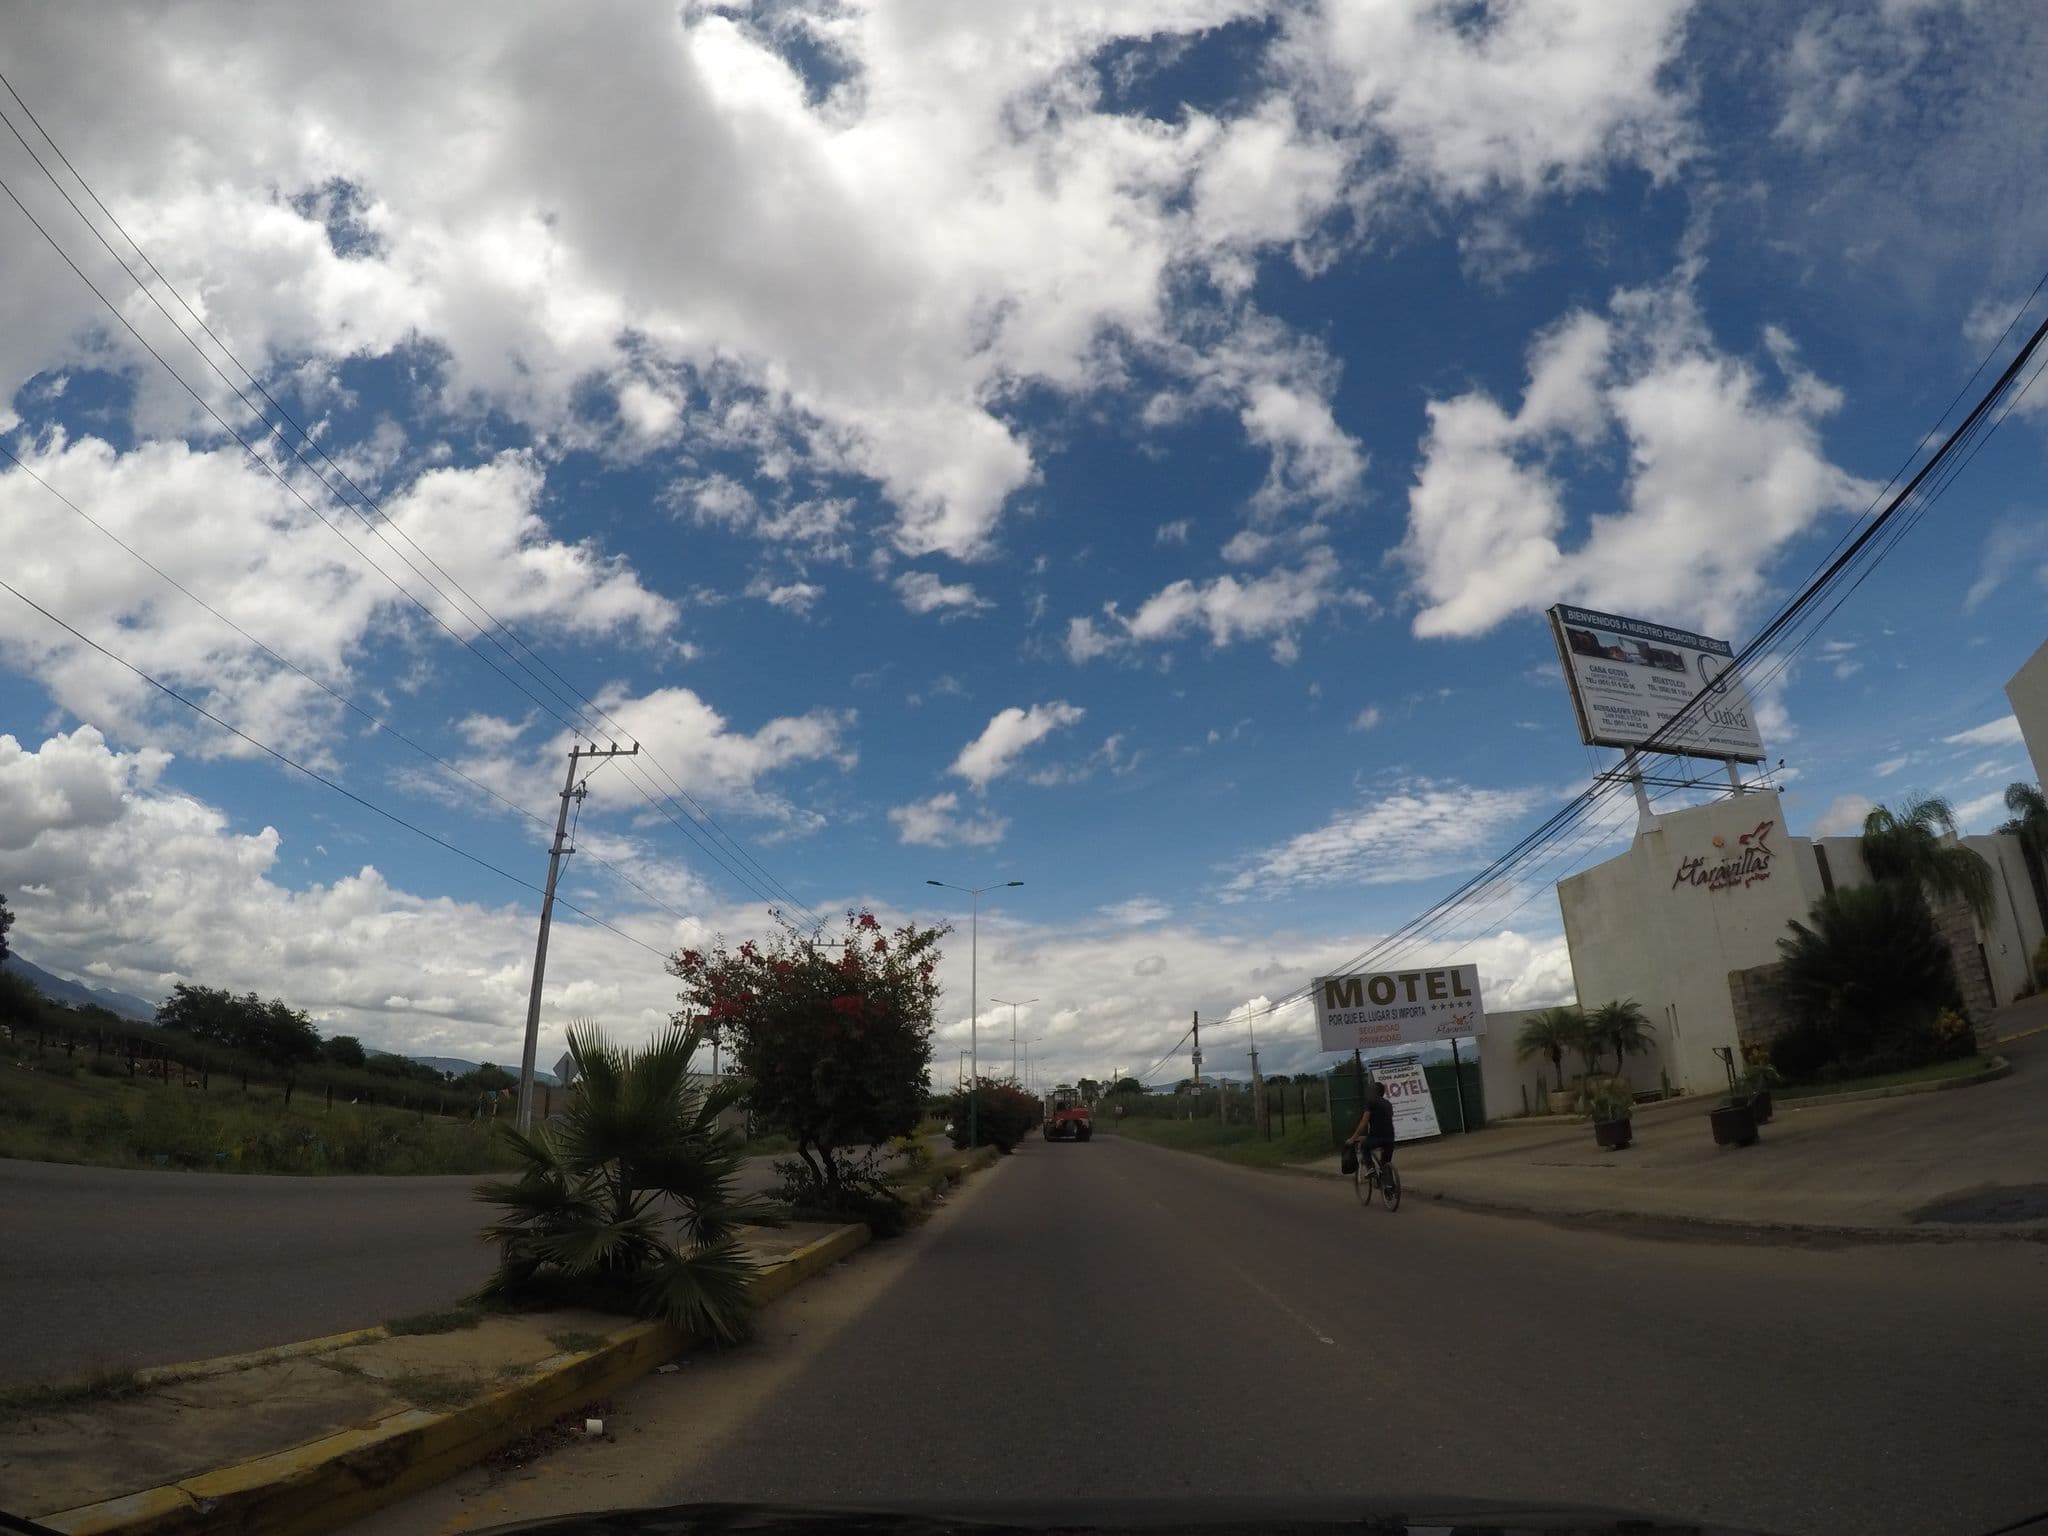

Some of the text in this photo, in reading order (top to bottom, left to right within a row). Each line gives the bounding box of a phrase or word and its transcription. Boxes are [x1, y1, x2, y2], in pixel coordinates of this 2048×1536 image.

[1567, 610, 1727, 653] BIENVENIDOS A NUESTRO PEDACITO DE CIELO
[1589, 665, 1607, 674] CASA
[1682, 855, 1705, 870] Las
[1672, 853, 1770, 890] Maravillas
[1324, 969, 1472, 1010] MOTEL
[1328, 1014, 1343, 1026] POR
[1343, 1012, 1359, 1025] QUE
[1359, 1011, 1368, 1023] EL
[1368, 1009, 1391, 1022] LUGAR
[1398, 1006, 1427, 1020] IMPORTA
[1359, 1023, 1400, 1035] SEGURIDAD
[1359, 1033, 1402, 1045] PRIVACIDAD
[1380, 1065, 1415, 1075] CONTAMOS
